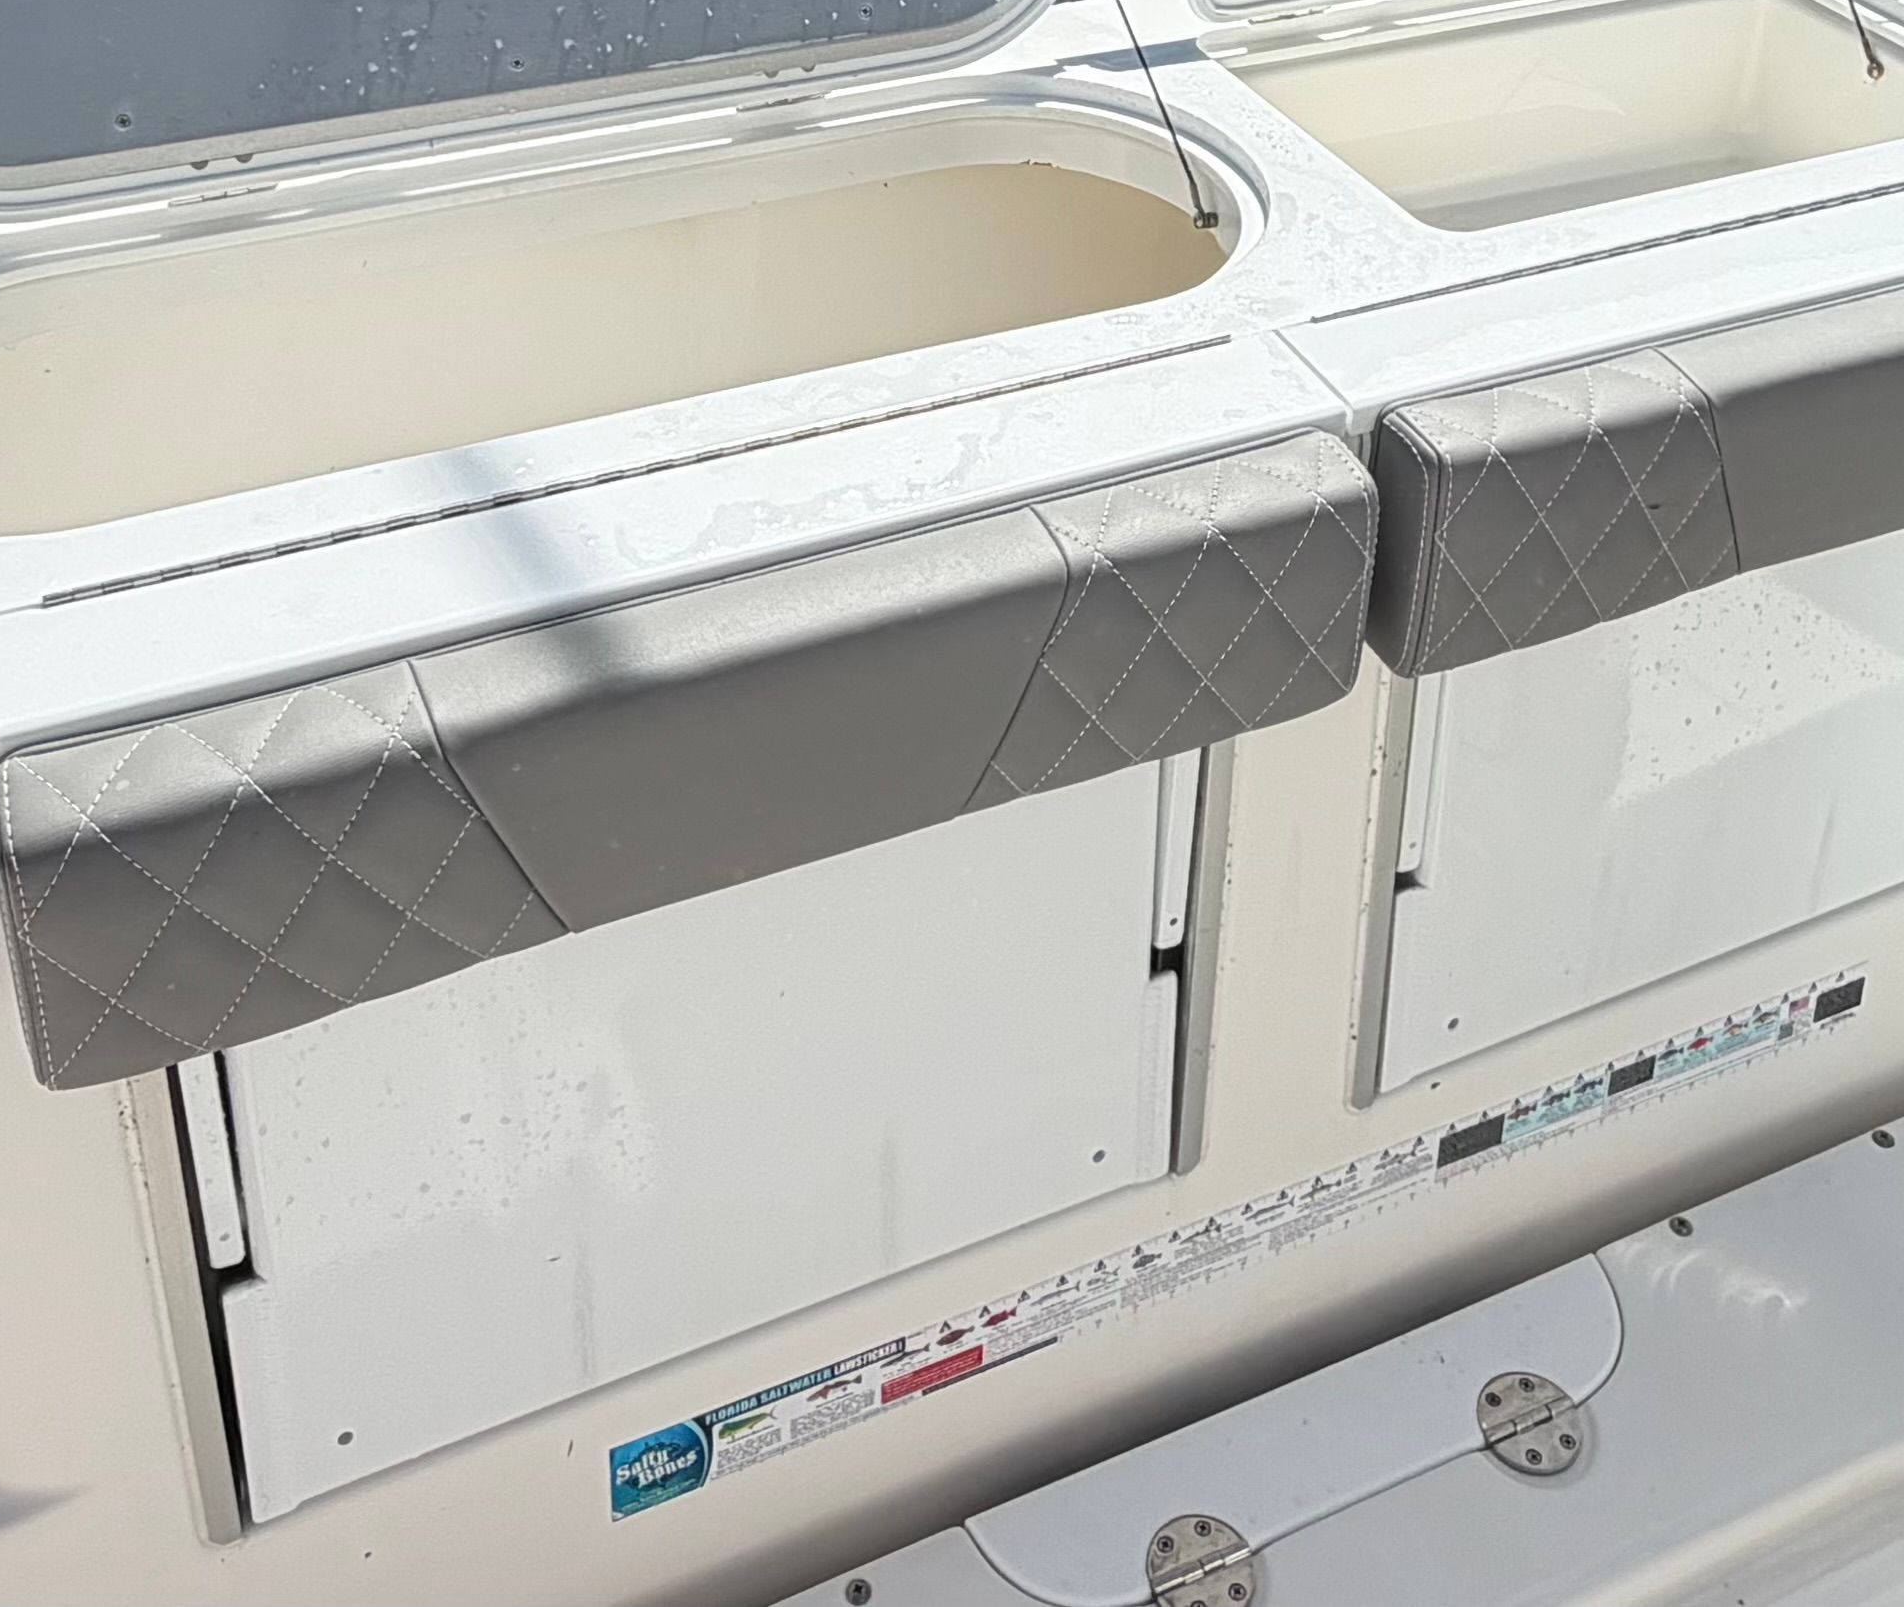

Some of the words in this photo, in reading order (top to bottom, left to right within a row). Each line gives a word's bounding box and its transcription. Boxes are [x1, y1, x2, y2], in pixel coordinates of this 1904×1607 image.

[705, 1396, 758, 1426] FLORIDA
[760, 1368, 832, 1404] SALTWATER
[616, 1449, 669, 1486] Salty
[637, 1449, 698, 1489] Bones
